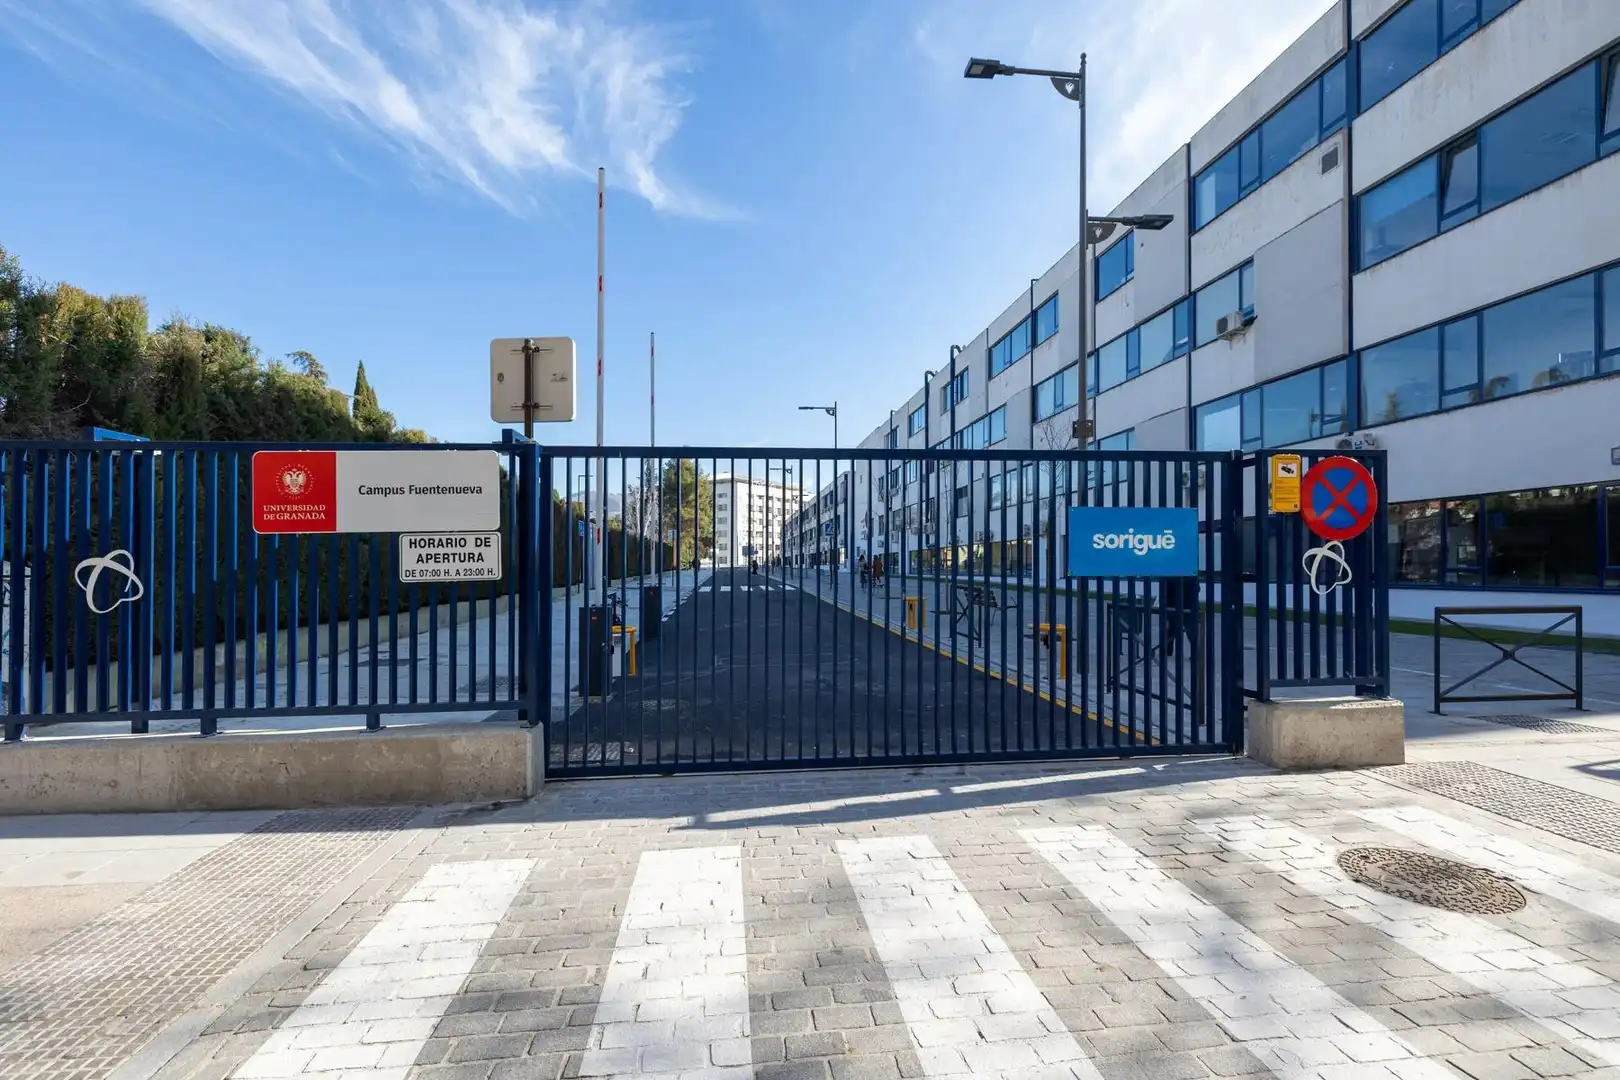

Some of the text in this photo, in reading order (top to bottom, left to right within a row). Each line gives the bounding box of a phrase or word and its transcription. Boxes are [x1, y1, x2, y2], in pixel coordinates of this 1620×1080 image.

[358, 484, 483, 497] Campus Fuentenueva
[263, 504, 326, 512] UNIVERSIDAD
[263, 512, 326, 521] DE GRANADA
[409, 537, 491, 549] HORARIO DE
[416, 552, 484, 564] APERTURA
[405, 567, 496, 578] DE 07:00 H. A 23:00 H.
